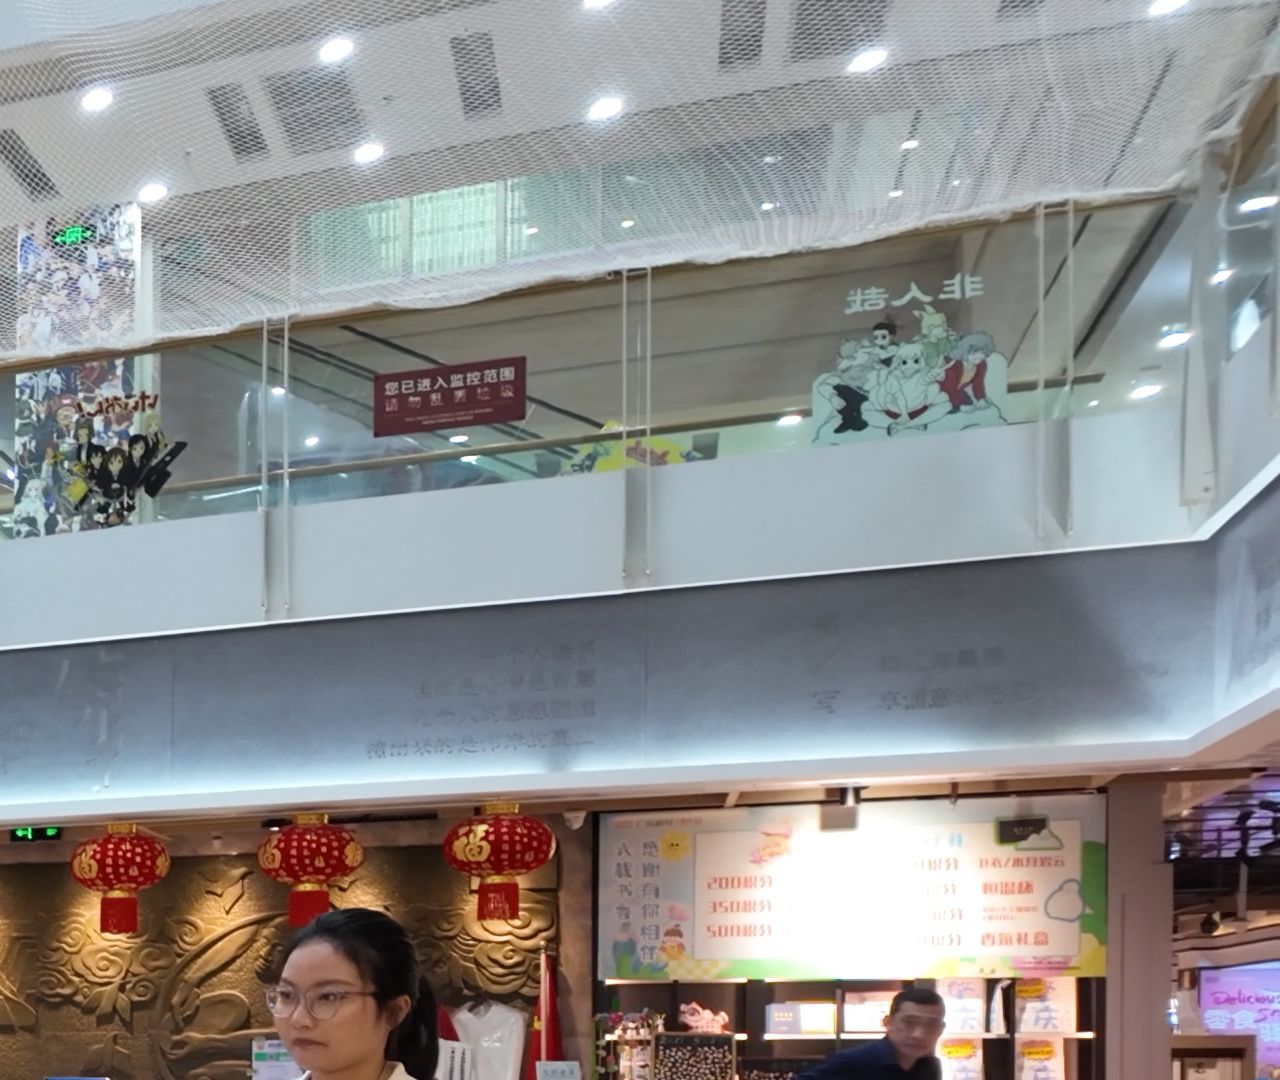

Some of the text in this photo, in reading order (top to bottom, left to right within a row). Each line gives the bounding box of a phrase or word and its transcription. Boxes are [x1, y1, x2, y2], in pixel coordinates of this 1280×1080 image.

[384, 366, 516, 396] 您已进入监控范围
[983, 881, 1035, 895] 恒温杯
[981, 931, 1049, 946] 香氛礼盒
